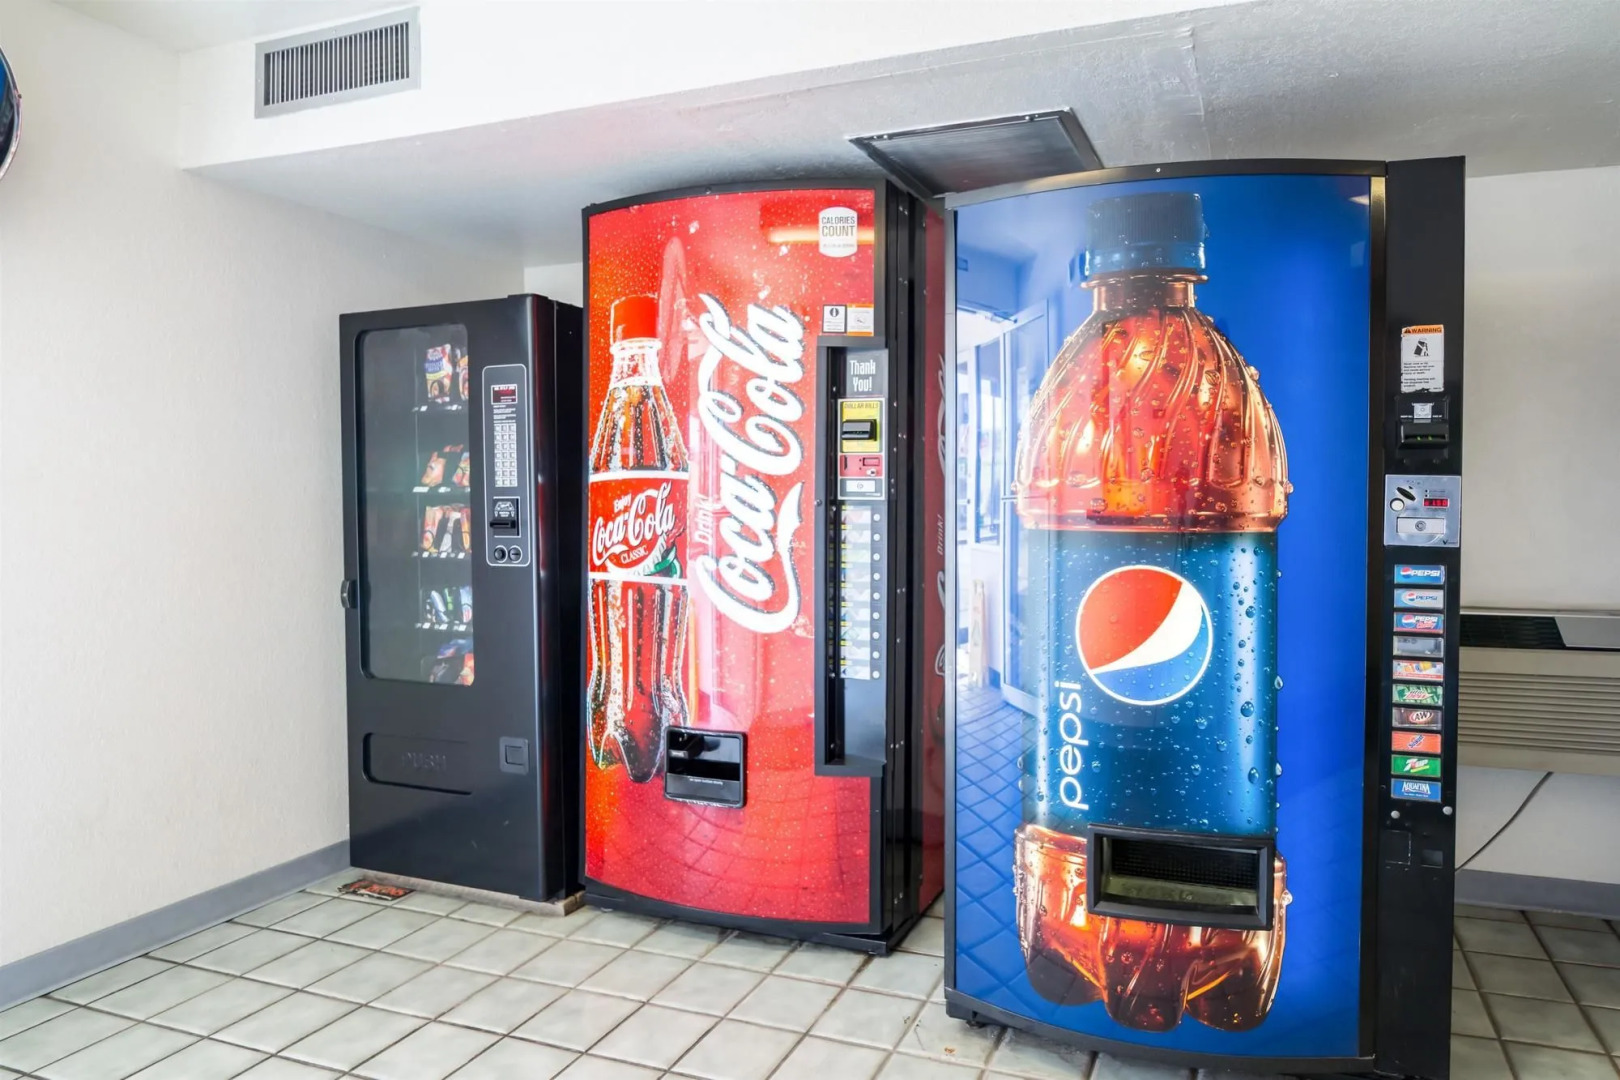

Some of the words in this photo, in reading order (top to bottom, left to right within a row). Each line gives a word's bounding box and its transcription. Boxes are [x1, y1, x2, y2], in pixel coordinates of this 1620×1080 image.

[821, 216, 855, 225] CALORIES
[821, 225, 855, 237] COUNT
[849, 359, 876, 375] Thank
[852, 376, 873, 392] You!
[694, 293, 805, 634] Coca-Cola
[613, 493, 632, 513] Enjoy
[592, 480, 675, 566] Coca-Cola
[620, 545, 649, 565] CLASSIC
[1411, 569, 1440, 577] PEPSI
[1054, 681, 1089, 810] pepsi
